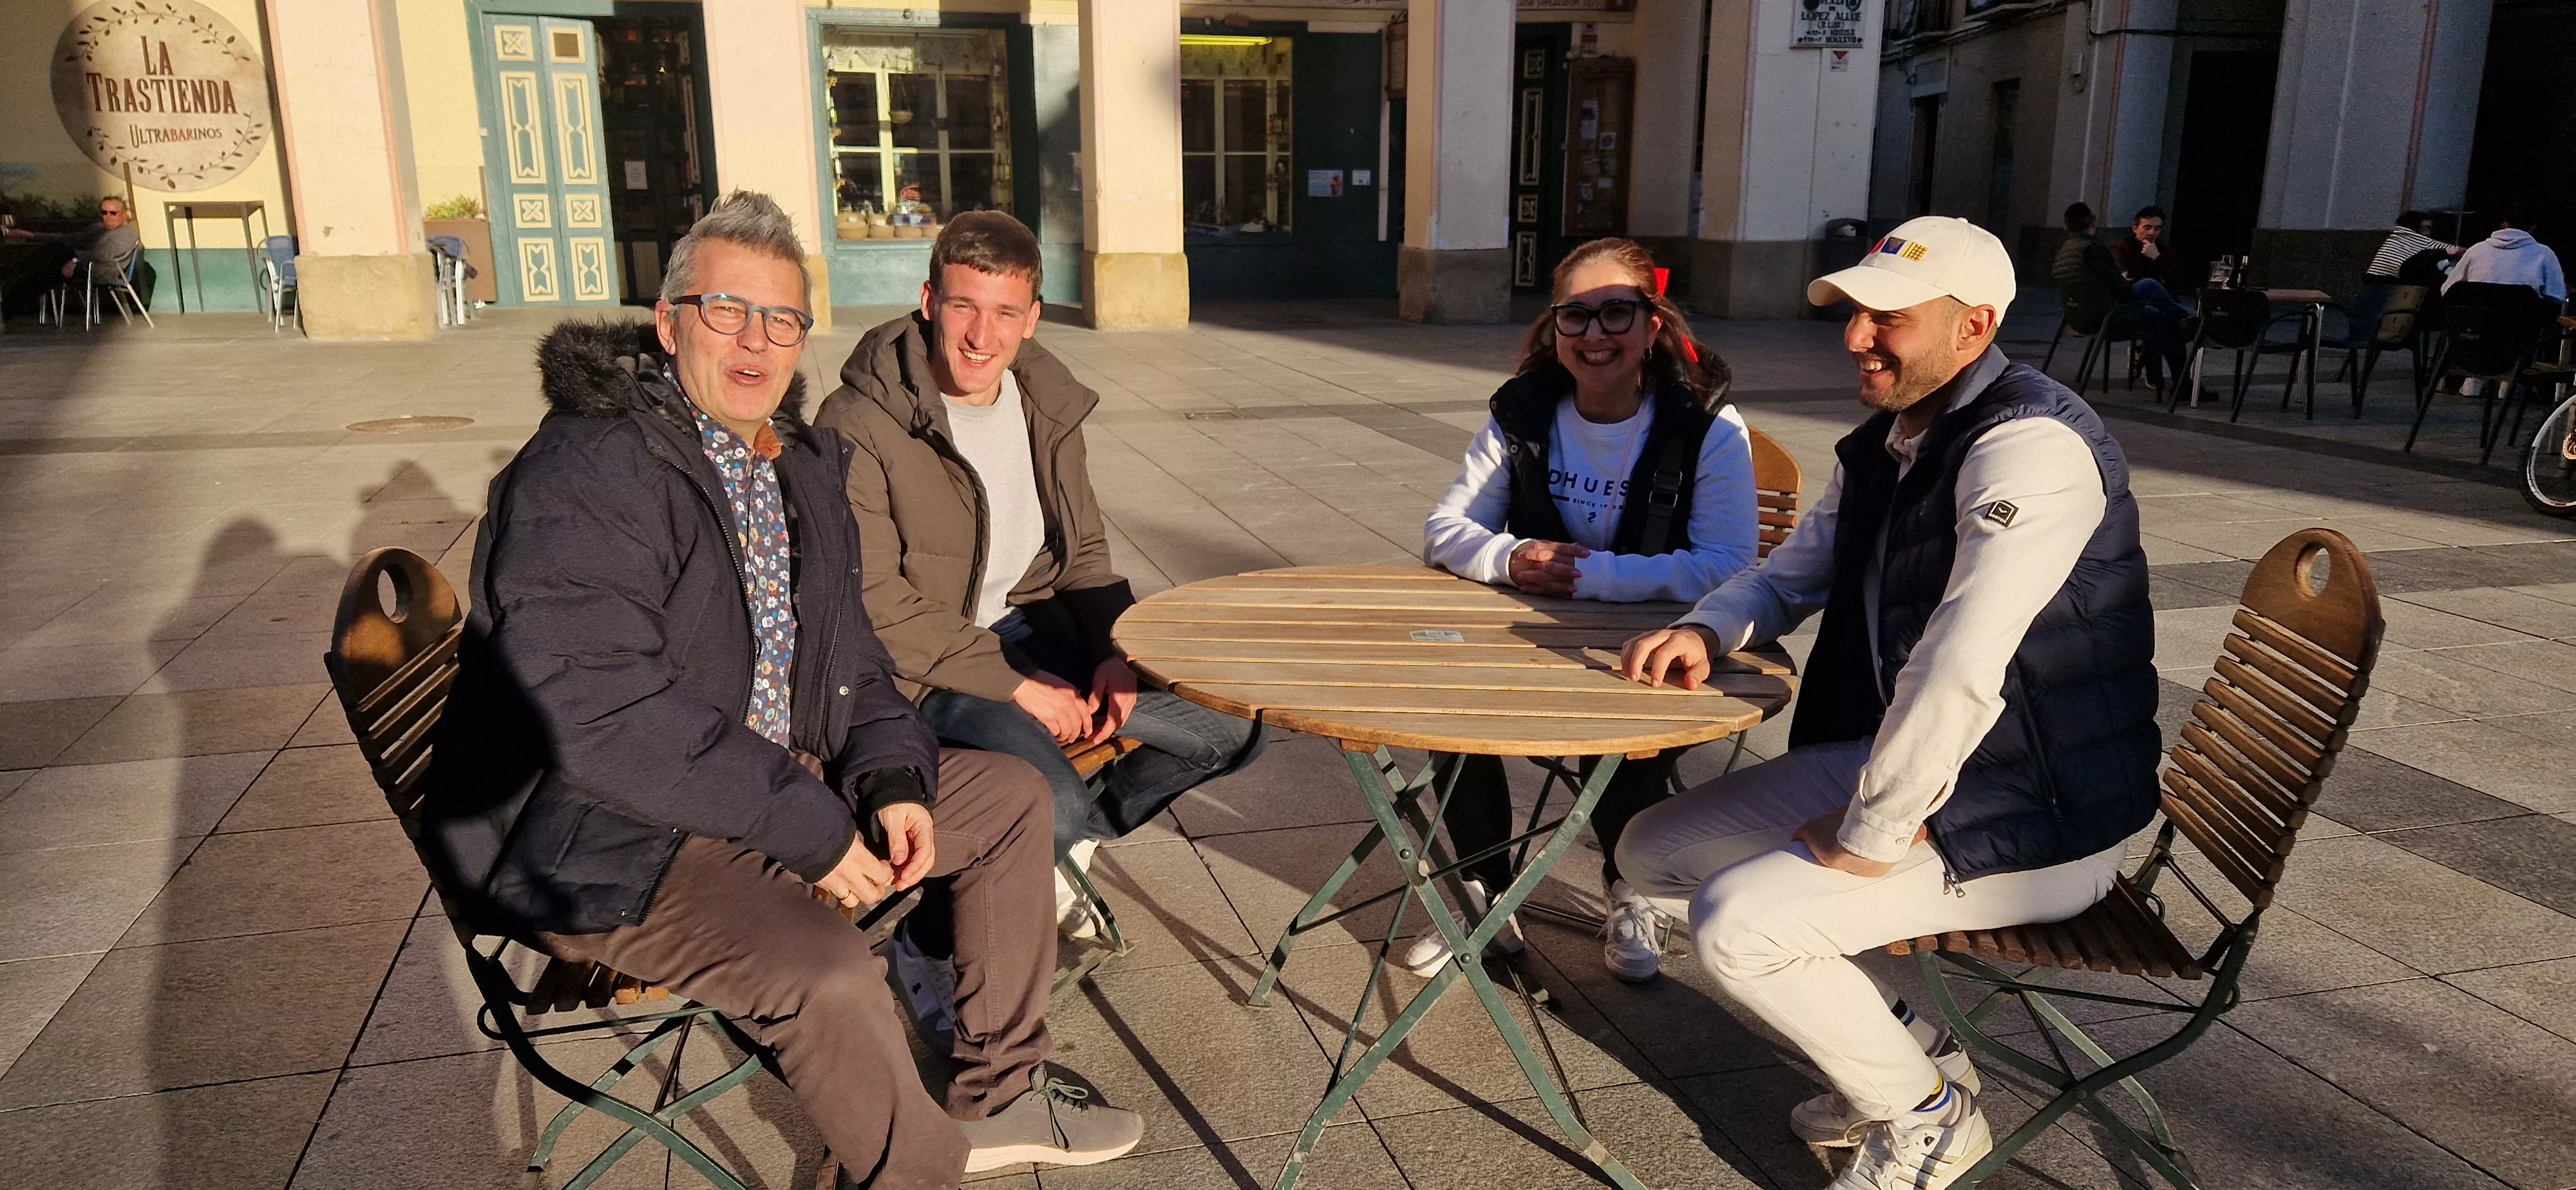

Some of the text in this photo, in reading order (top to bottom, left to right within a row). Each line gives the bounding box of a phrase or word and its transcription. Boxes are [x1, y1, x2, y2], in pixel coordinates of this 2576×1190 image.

[141, 35, 173, 75] LA
[86, 72, 237, 114] TRASTIENDA
[129, 124, 222, 148] ULTRABARINOS
[1573, 498, 1596, 508] SINCE
